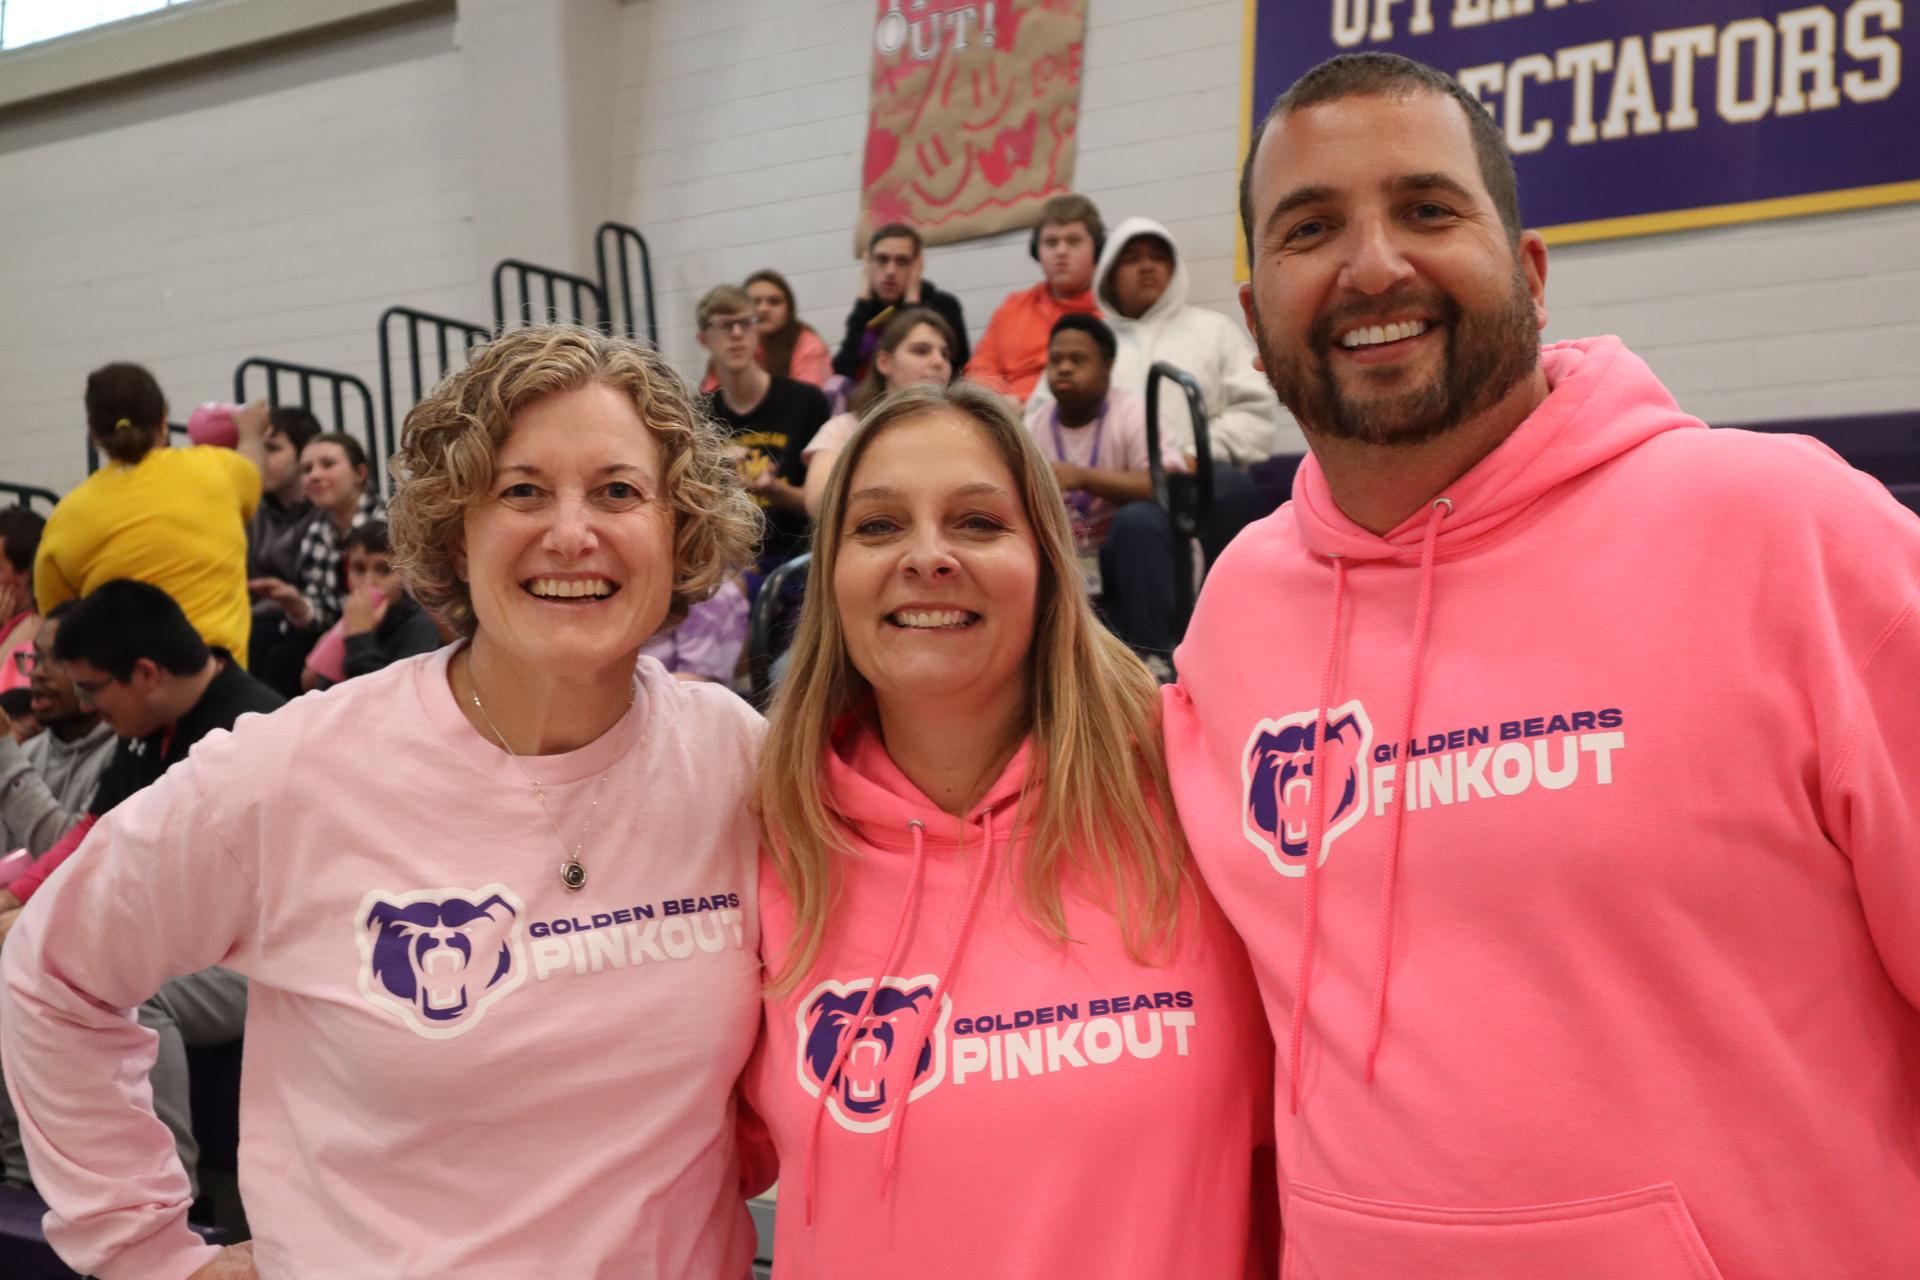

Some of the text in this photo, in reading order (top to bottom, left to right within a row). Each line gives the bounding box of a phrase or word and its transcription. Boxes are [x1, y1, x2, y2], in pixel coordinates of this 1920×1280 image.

[876, 1, 996, 60] OUT!
[1499, 708, 1624, 740] BEARS
[1372, 731, 1625, 817] PINKOUT
[529, 892, 741, 938] GOLDEN BEARS
[531, 911, 743, 980] PINKOUT
[953, 991, 1194, 1035] GOLDEN BEARS
[952, 1011, 1197, 1085] PINKOUT
